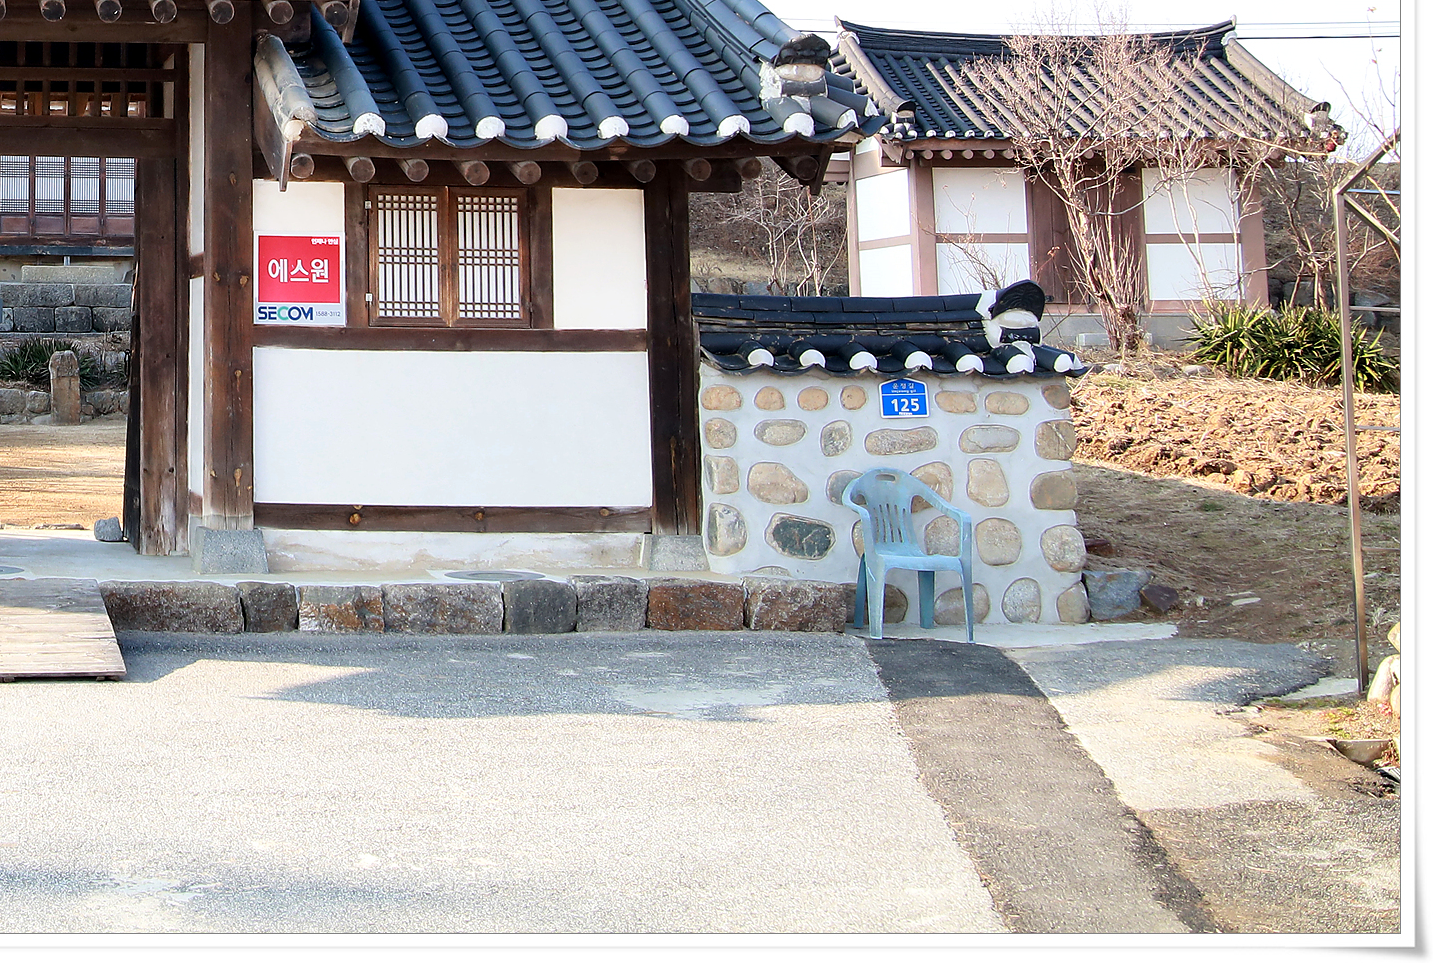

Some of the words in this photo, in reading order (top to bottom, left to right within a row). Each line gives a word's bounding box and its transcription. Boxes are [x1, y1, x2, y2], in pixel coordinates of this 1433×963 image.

[268, 259, 329, 283] 에스원
[258, 306, 313, 321] SECOM
[891, 398, 920, 412] 125
